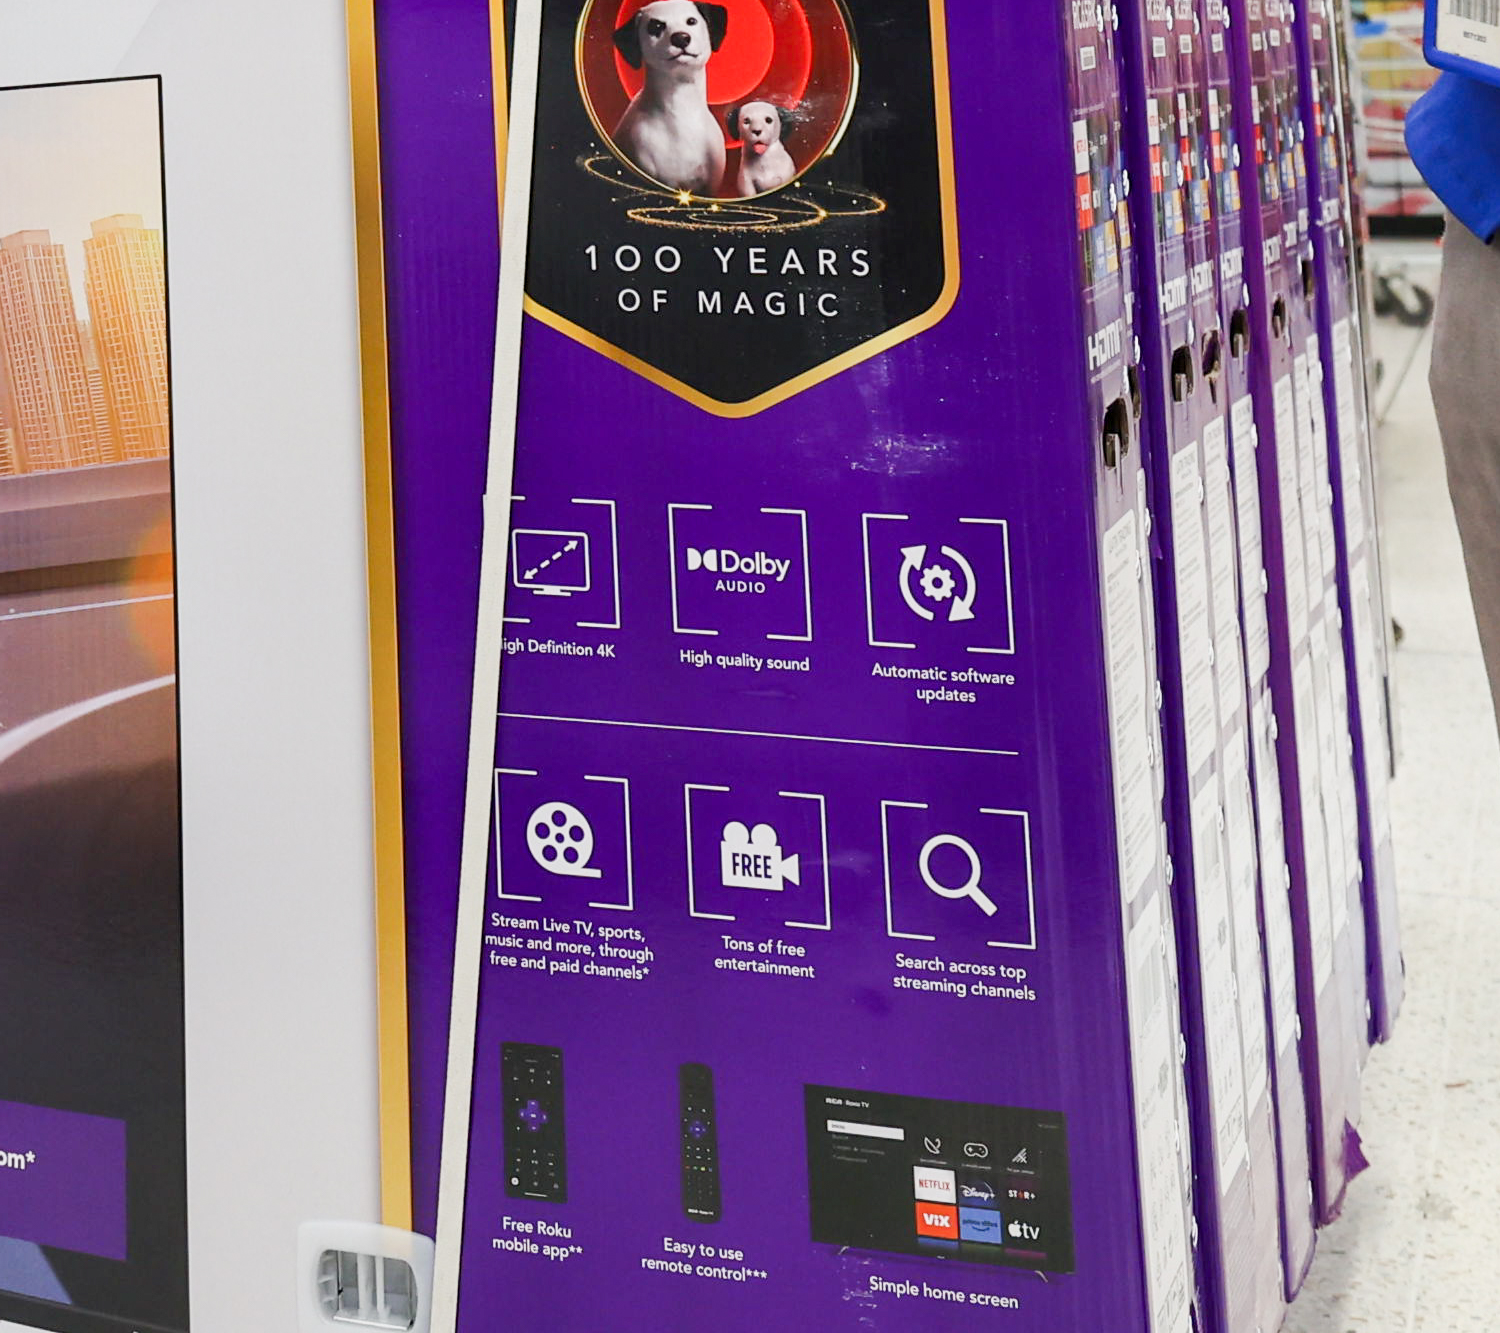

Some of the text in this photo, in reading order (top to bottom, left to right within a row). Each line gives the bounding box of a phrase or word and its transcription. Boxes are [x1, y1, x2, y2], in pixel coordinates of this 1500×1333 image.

[584, 245, 872, 278] 100 YEARS
[617, 288, 840, 317] OF MAGIC
[721, 549, 791, 581] Dolby
[715, 579, 766, 594] AUDIO
[501, 637, 615, 658] igh Definition 4K
[680, 648, 810, 672] High quality sound
[872, 662, 1015, 685] Automatic software
[916, 686, 976, 705] updates
[732, 852, 772, 880] FREE
[492, 913, 645, 943] Stream Live TV, sports,
[485, 932, 654, 963] music and more, through
[721, 936, 805, 959] Tons of free
[490, 952, 515, 969] free
[518, 954, 545, 972] and
[549, 957, 580, 977] paid
[714, 957, 815, 979] entertainment
[895, 953, 1026, 982] Search across top
[893, 973, 1036, 1001] streaming channels
[919, 1179, 950, 1191] NETFLIX
[503, 1217, 572, 1239] Free Roku
[1022, 1223, 1040, 1240] tv
[492, 1236, 539, 1256] mobile
[663, 1237, 743, 1262] Easy to use
[641, 1256, 692, 1277] remote
[869, 1276, 1019, 1310] Simple home screen
